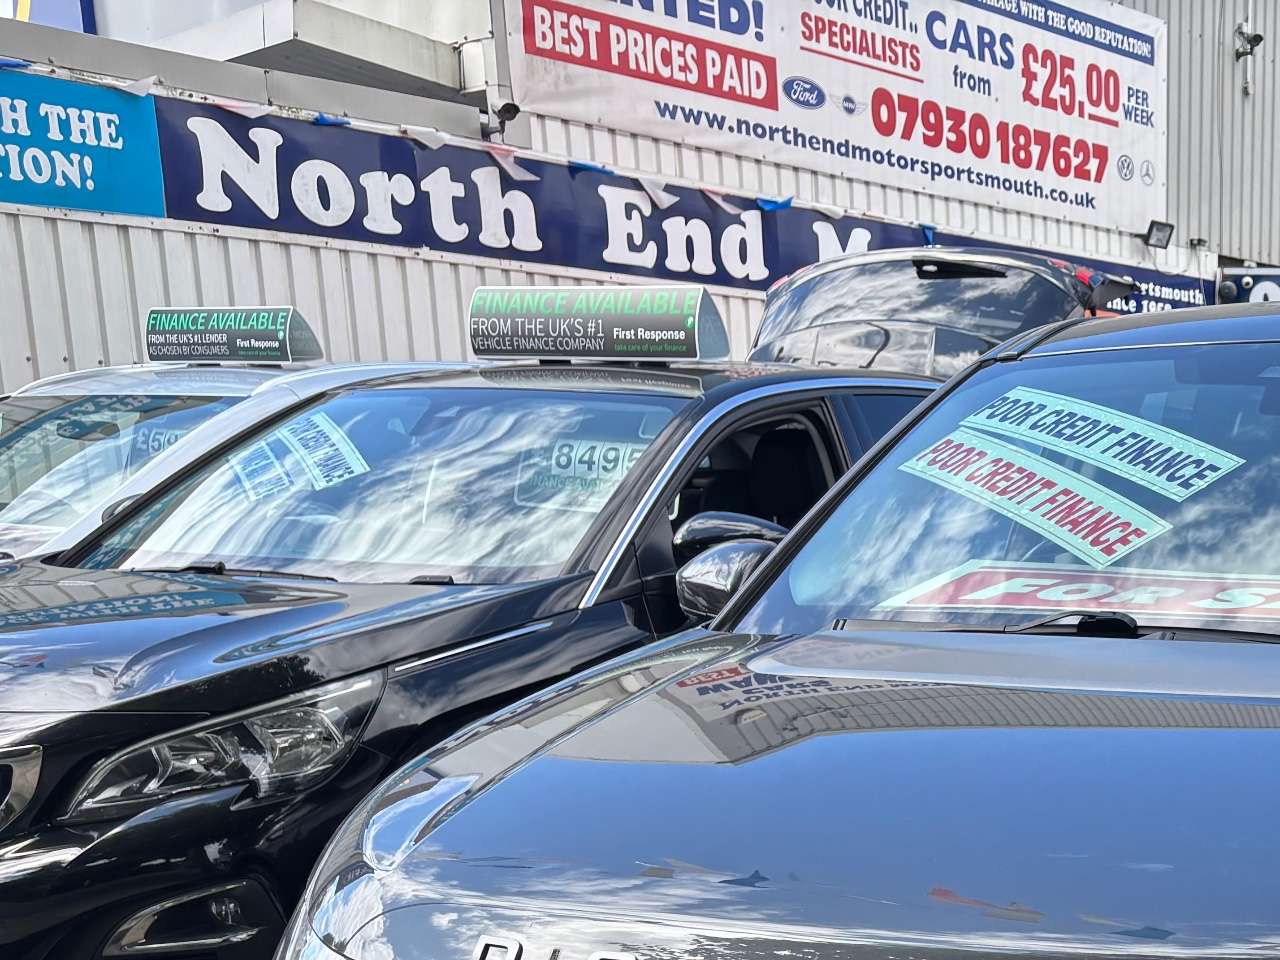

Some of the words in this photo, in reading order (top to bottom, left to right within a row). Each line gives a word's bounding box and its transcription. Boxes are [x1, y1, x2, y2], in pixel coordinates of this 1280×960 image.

[1019, 1, 1045, 23] WITH
[1047, 10, 1067, 30] THE
[1068, 17, 1094, 39] GOOD
[534, 5, 601, 61] BEST
[609, 26, 699, 85] PRICES
[705, 49, 768, 100] PAID
[800, 12, 921, 72] SPECIALISTS
[925, 10, 1015, 70] CARS
[791, 80, 818, 105] Ford
[952, 65, 992, 97] from
[1022, 43, 1120, 118] £25.00
[1128, 86, 1149, 107] PER
[39, 102, 124, 150] THE
[1123, 103, 1154, 128] WEEK
[871, 87, 990, 159] 07930
[996, 121, 1109, 184] 187627
[653, 100, 1097, 209] www.northendmotorsportsmouth.co.uk
[187, 116, 543, 252] North
[598, 184, 770, 281] End
[472, 291, 567, 315] FINANCE
[573, 290, 697, 315] AVAILABLE
[1122, 275, 1204, 305] rtsmouth
[149, 312, 207, 330] FINANCE
[208, 311, 286, 330] AVAILABLE
[471, 318, 511, 336] FROM
[515, 318, 545, 336] THE
[549, 318, 583, 337] UK'S
[587, 318, 604, 337] #1
[613, 328, 635, 339] First
[637, 328, 686, 342] Response
[148, 333, 165, 343] FROM
[166, 333, 178, 343] THE
[202, 333, 227, 343] LENDER
[150, 345, 158, 355] AS
[158, 345, 181, 356] CHOSEN
[181, 345, 190, 356] BY
[190, 345, 229, 356] CONSUMERS
[236, 339, 249, 348] First
[250, 339, 279, 350] Response
[472, 337, 512, 350] VEHICLE
[514, 337, 555, 350] FINANCE
[556, 337, 605, 351] COMPANY
[973, 396, 1033, 427] POOR
[1030, 404, 1124, 448] CREDIT
[1101, 429, 1223, 489] FINANCE
[915, 437, 975, 475] POOR
[965, 454, 1058, 506] CREDIT
[1028, 487, 1147, 557] FINANCE
[960, 577, 1183, 603] FOR
